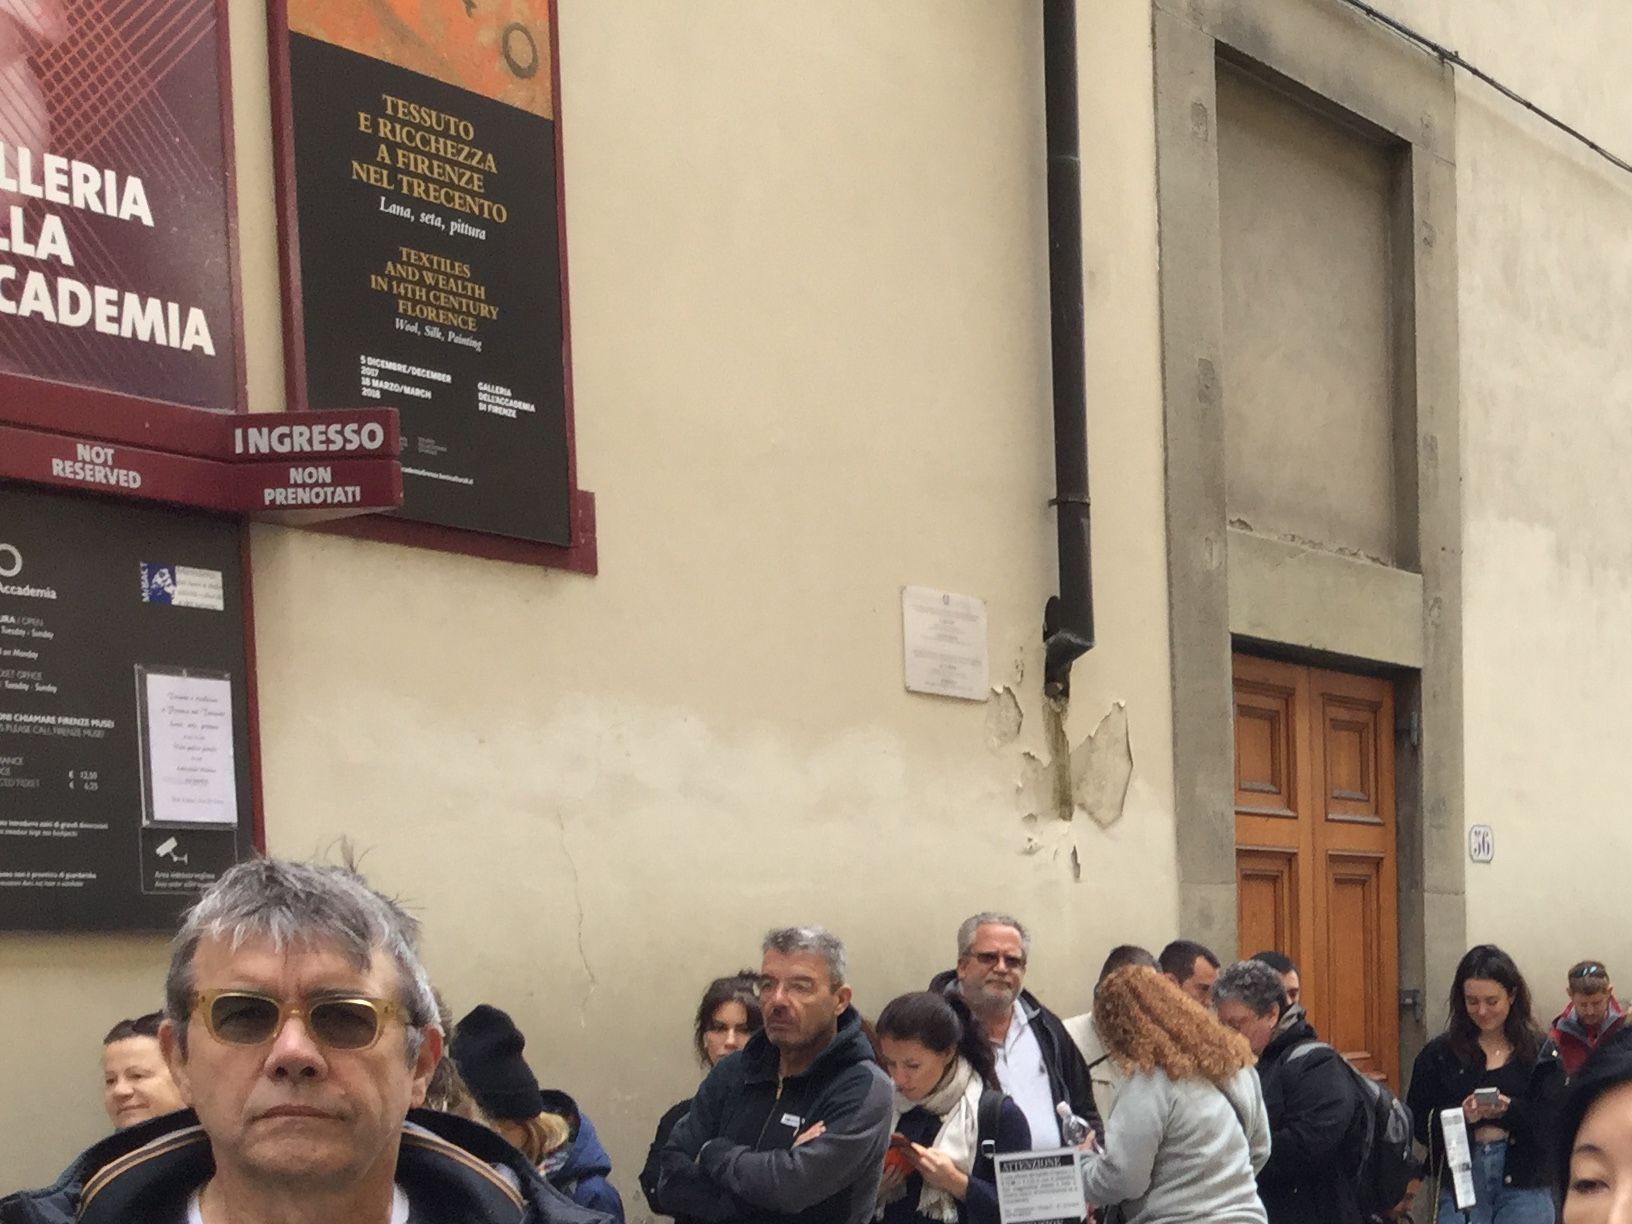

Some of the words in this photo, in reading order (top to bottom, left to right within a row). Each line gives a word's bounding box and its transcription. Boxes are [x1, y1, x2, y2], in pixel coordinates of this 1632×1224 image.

[382, 93, 475, 141] TESSUTO
[358, 111, 372, 133] E
[377, 117, 498, 175] RICCHEZZA
[0, 141, 154, 227] LLERIA
[376, 143, 392, 165] A
[396, 149, 485, 193] FIRENZE
[351, 160, 394, 190] NEL
[397, 174, 508, 224] TRECENTO
[379, 196, 415, 222] Lana,
[419, 211, 445, 231] seta,
[450, 218, 486, 240] pittura
[0, 205, 75, 266] LA
[399, 246, 471, 278] TEXTILES
[384, 261, 420, 282] AND
[422, 270, 486, 300] WEALTH
[370, 274, 388, 292] IN
[391, 280, 427, 301] 14TH
[429, 290, 499, 320] CENTURY
[397, 299, 478, 332] FLORENCE
[395, 317, 421, 336] Wool,
[424, 325, 445, 342] Silk,
[448, 331, 482, 352] Painting
[360, 355, 366, 365] 5
[367, 356, 452, 383] DICEMBRE/DECEMBER
[360, 365, 379, 378] 2017
[361, 387, 381, 400] 2018
[372, 379, 432, 400] MARZO/MARCH
[477, 381, 512, 397] GALLERIA
[478, 392, 536, 413] DELL'ACCADEMIA
[478, 402, 487, 412] DI
[488, 403, 518, 419] FIRENZE
[234, 422, 385, 454] INGRESSO
[76, 443, 114, 466] NOT
[52, 458, 142, 489] RESERVED
[290, 467, 332, 484] NON
[264, 486, 361, 506] PRENOTATI
[1001, 1157, 1062, 1172] ATTENZIONE
